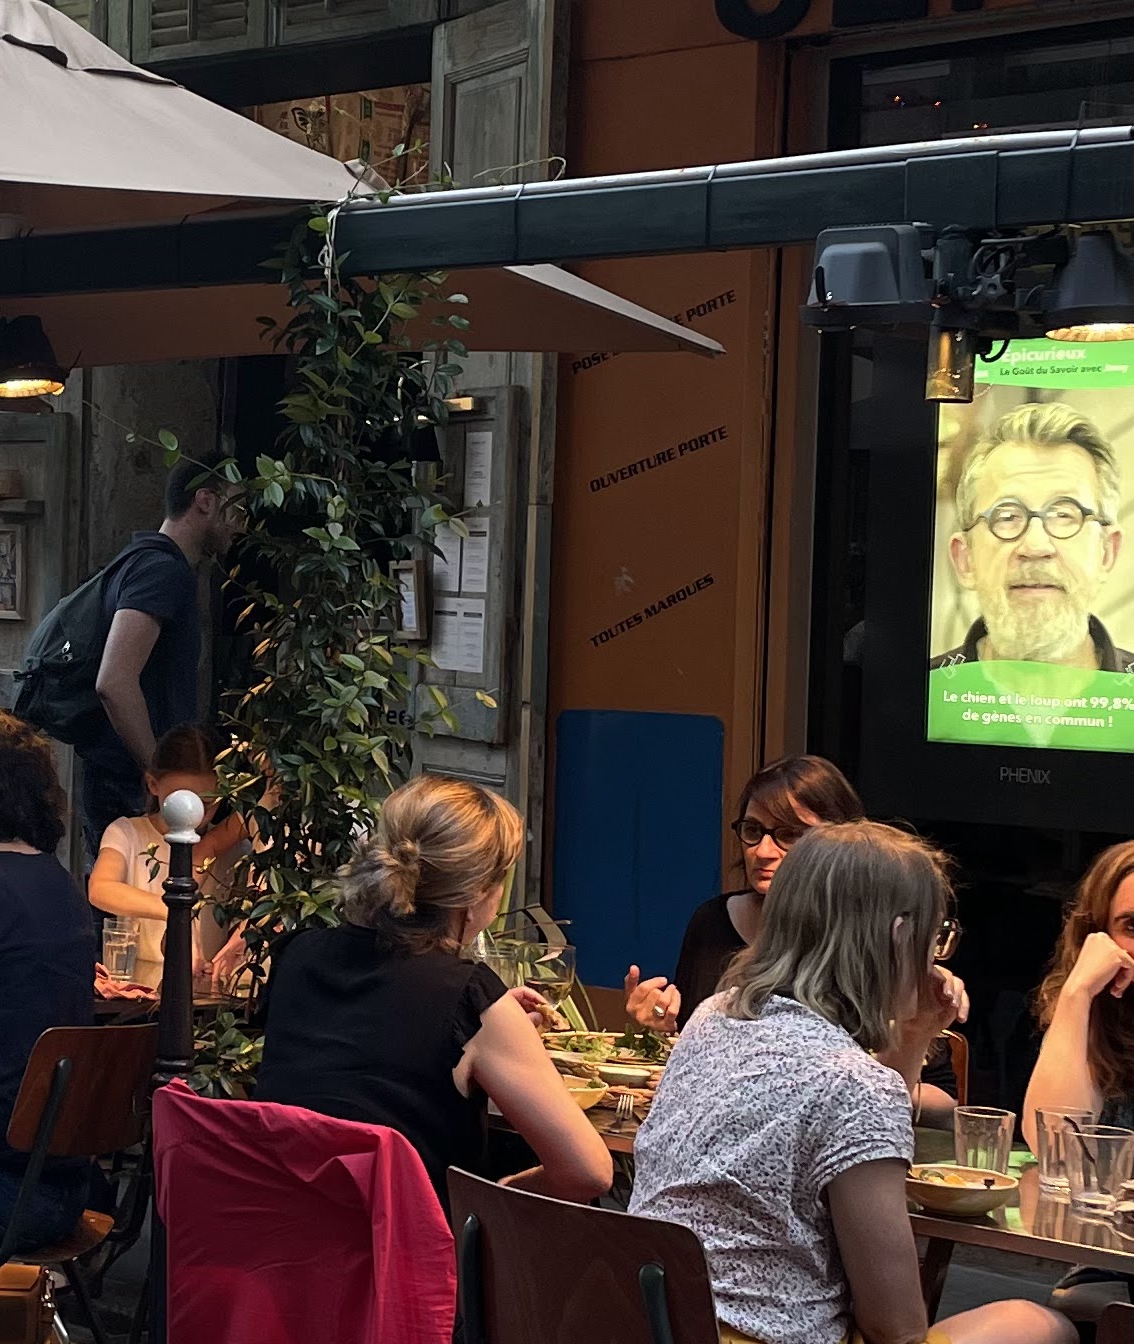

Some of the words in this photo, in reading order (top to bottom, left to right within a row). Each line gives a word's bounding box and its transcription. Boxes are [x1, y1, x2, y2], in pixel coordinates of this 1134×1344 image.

[686, 289, 737, 322] PORTE
[1036, 365, 1048, 375] du
[1049, 364, 1079, 374] Savoir
[1080, 365, 1102, 373] avec
[589, 447, 677, 493] OUVERTURE
[678, 425, 729, 457] PORTE
[589, 612, 644, 648] TOUTES
[644, 573, 714, 619] MARQUES
[943, 689, 958, 703] Le
[961, 690, 996, 704] chien
[999, 693, 1013, 705] et
[1015, 692, 1027, 706] le
[1030, 693, 1061, 709] loup
[1064, 697, 1088, 708] ont
[1090, 696, 1134, 712] 99,8%
[962, 708, 979, 722] de
[981, 709, 1022, 725] gènes
[1025, 715, 1042, 724] en
[1045, 716, 1105, 728] commun
[999, 766, 1051, 784] PHENIX
